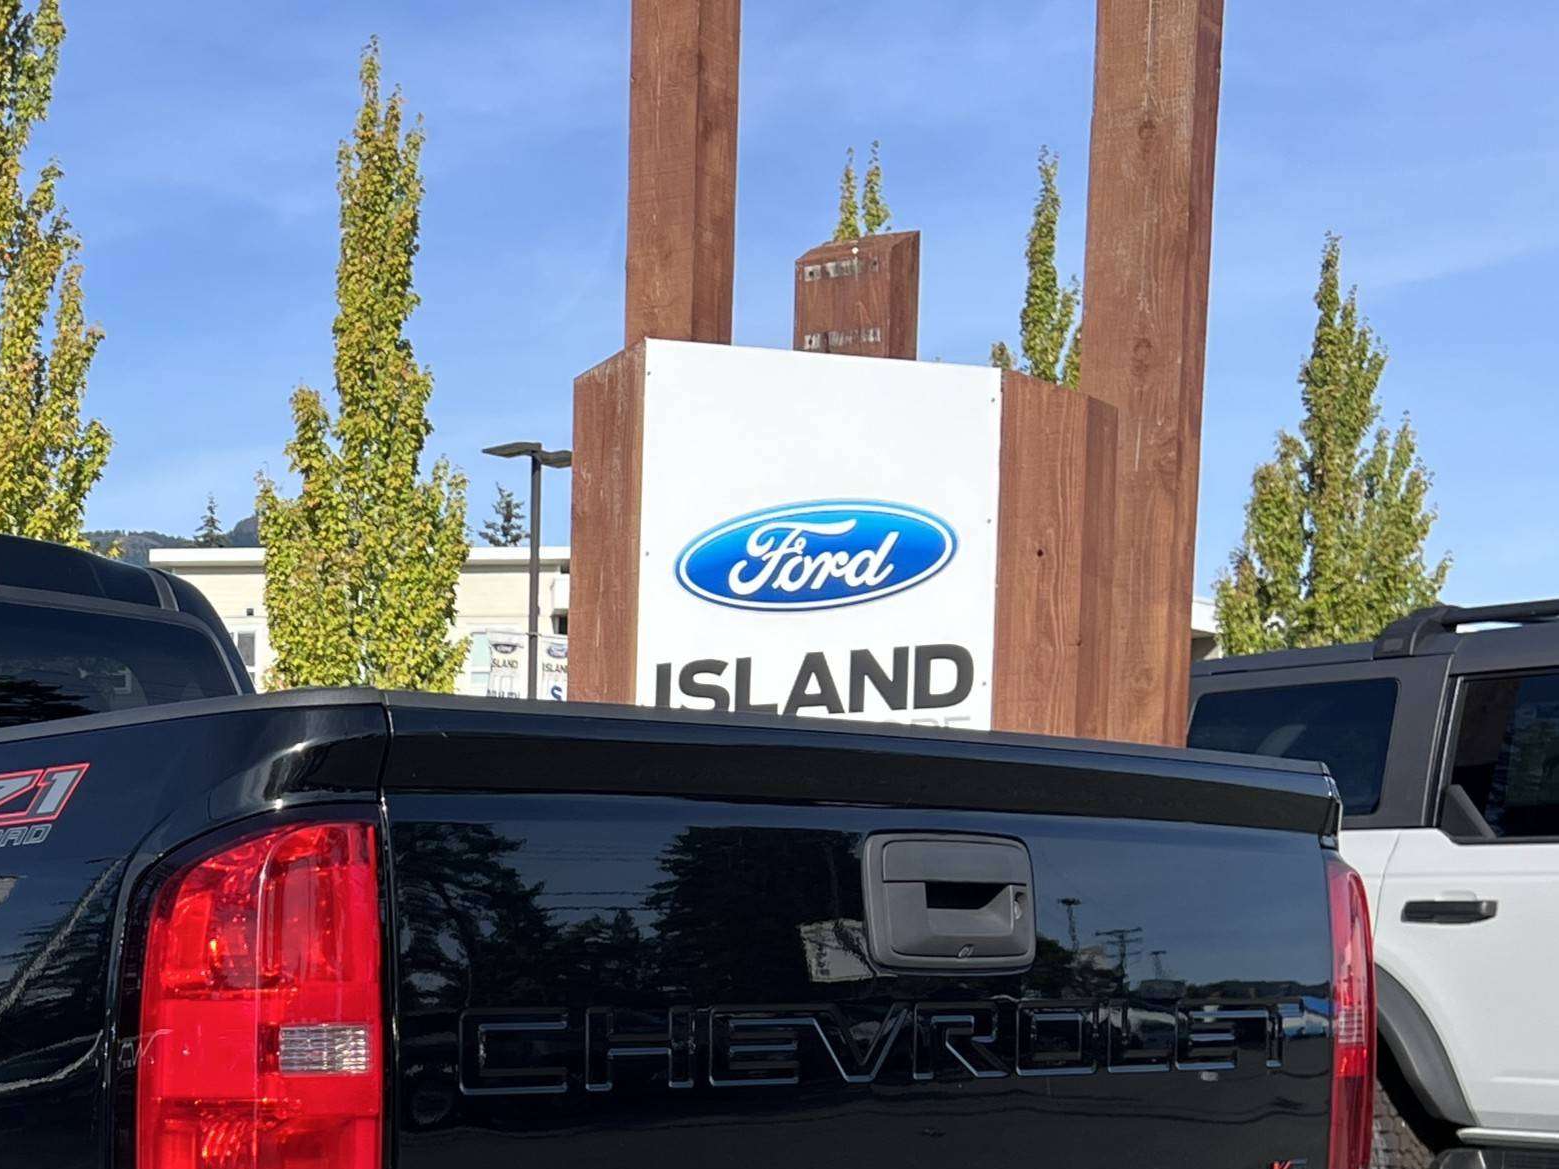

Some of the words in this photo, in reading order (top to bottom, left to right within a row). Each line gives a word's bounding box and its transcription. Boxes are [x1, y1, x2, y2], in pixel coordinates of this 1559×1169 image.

[728, 518, 900, 596] Ford
[654, 643, 975, 716] ISLAND
[458, 999, 1303, 1096] CHEVROLET
